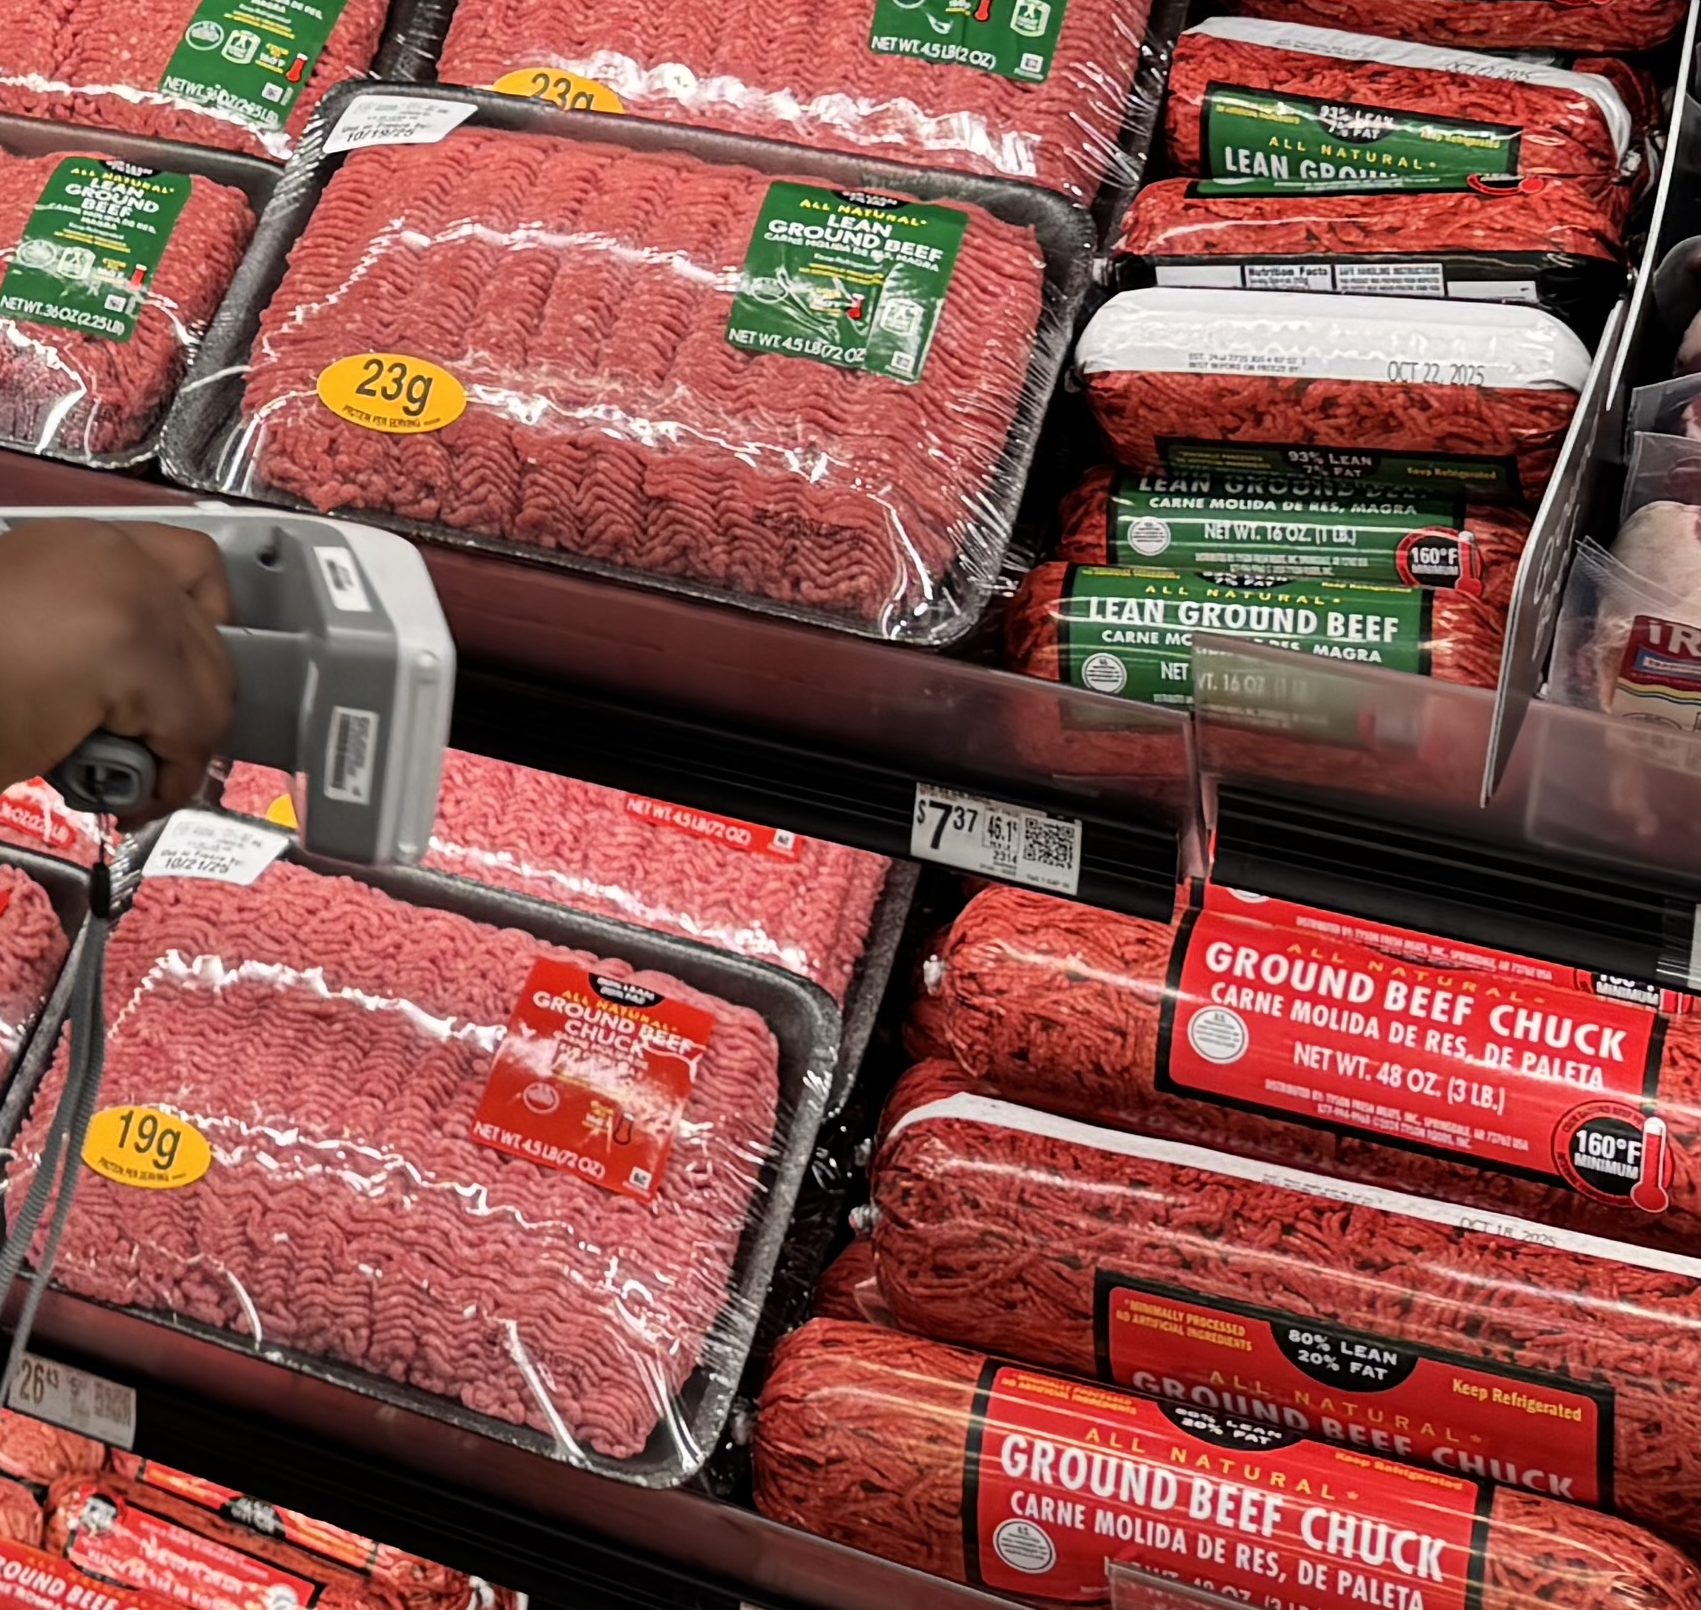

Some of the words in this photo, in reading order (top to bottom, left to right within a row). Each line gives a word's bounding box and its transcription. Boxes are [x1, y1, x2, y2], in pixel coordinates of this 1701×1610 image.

[65, 183, 160, 213] GROUND
[90, 178, 145, 198] LEAN
[81, 198, 134, 218] BEEF
[768, 219, 881, 249] GROUND
[884, 239, 943, 263] BEEF
[827, 214, 893, 238] LEAN
[1248, 266, 1294, 277] Nutrition
[1299, 266, 1328, 277] Facts
[729, 328, 757, 342] NET
[355, 358, 433, 417] 23g
[1288, 450, 1324, 466] 93%
[1329, 452, 1372, 467] LEAN
[1149, 497, 1205, 509] CARNE
[1210, 498, 1276, 511] MOLIDA
[1282, 500, 1303, 511] DE
[1309, 501, 1344, 514] RES,
[1351, 503, 1417, 516] MAGRA
[1205, 523, 1230, 540] NET
[1233, 524, 1260, 541] WT.
[1267, 525, 1282, 542] 16
[1286, 526, 1311, 543] OZ.
[1412, 547, 1458, 564] 160°F
[1089, 596, 1164, 623] LEAN
[1178, 601, 1318, 634] GROUND
[1327, 611, 1399, 643] BEEF
[1102, 630, 1159, 645] CARNE
[1313, 644, 1382, 663] MAGRA
[1160, 662, 1189, 681] NET
[1206, 941, 1374, 1003] GROUND
[1383, 979, 1475, 1026] BEEF
[1489, 1004, 1627, 1063] CHUCK
[533, 991, 635, 1035] GROUND
[638, 1024, 694, 1055] BEEF
[1210, 982, 1284, 1019] CARNE
[1290, 998, 1381, 1039] MOLIDA
[1388, 1016, 1417, 1047] DE
[1425, 1024, 1474, 1063] RES,
[1484, 1041, 1512, 1069] DE
[1522, 1051, 1604, 1092] PALETA
[564, 1019, 647, 1059] CHUCK
[1294, 1041, 1332, 1073] NET
[1336, 1051, 1370, 1082] WT.
[1376, 1062, 1403, 1089] 48
[1406, 1068, 1441, 1097] OZ.
[1447, 1075, 1466, 1106] (3
[1470, 1082, 1505, 1116] LB.)
[118, 1109, 181, 1171] 19g
[1297, 1350, 1340, 1372] 20%
[1350, 1361, 1388, 1381] FAT
[1452, 1378, 1489, 1398] Keep
[1492, 1387, 1582, 1423] Refrigerated
[1000, 1434, 1177, 1511] GROUND
[1188, 1479, 1285, 1539] BEEF
[1301, 1507, 1447, 1583] CHUCK
[1010, 1490, 1085, 1531] CARNE
[1095, 1509, 1187, 1556] MOLIDA
[1197, 1535, 1226, 1564] DE
[1234, 1544, 1287, 1583] RES,
[1298, 1559, 1327, 1589] DE
[1337, 1572, 1424, 1610] PALETA
